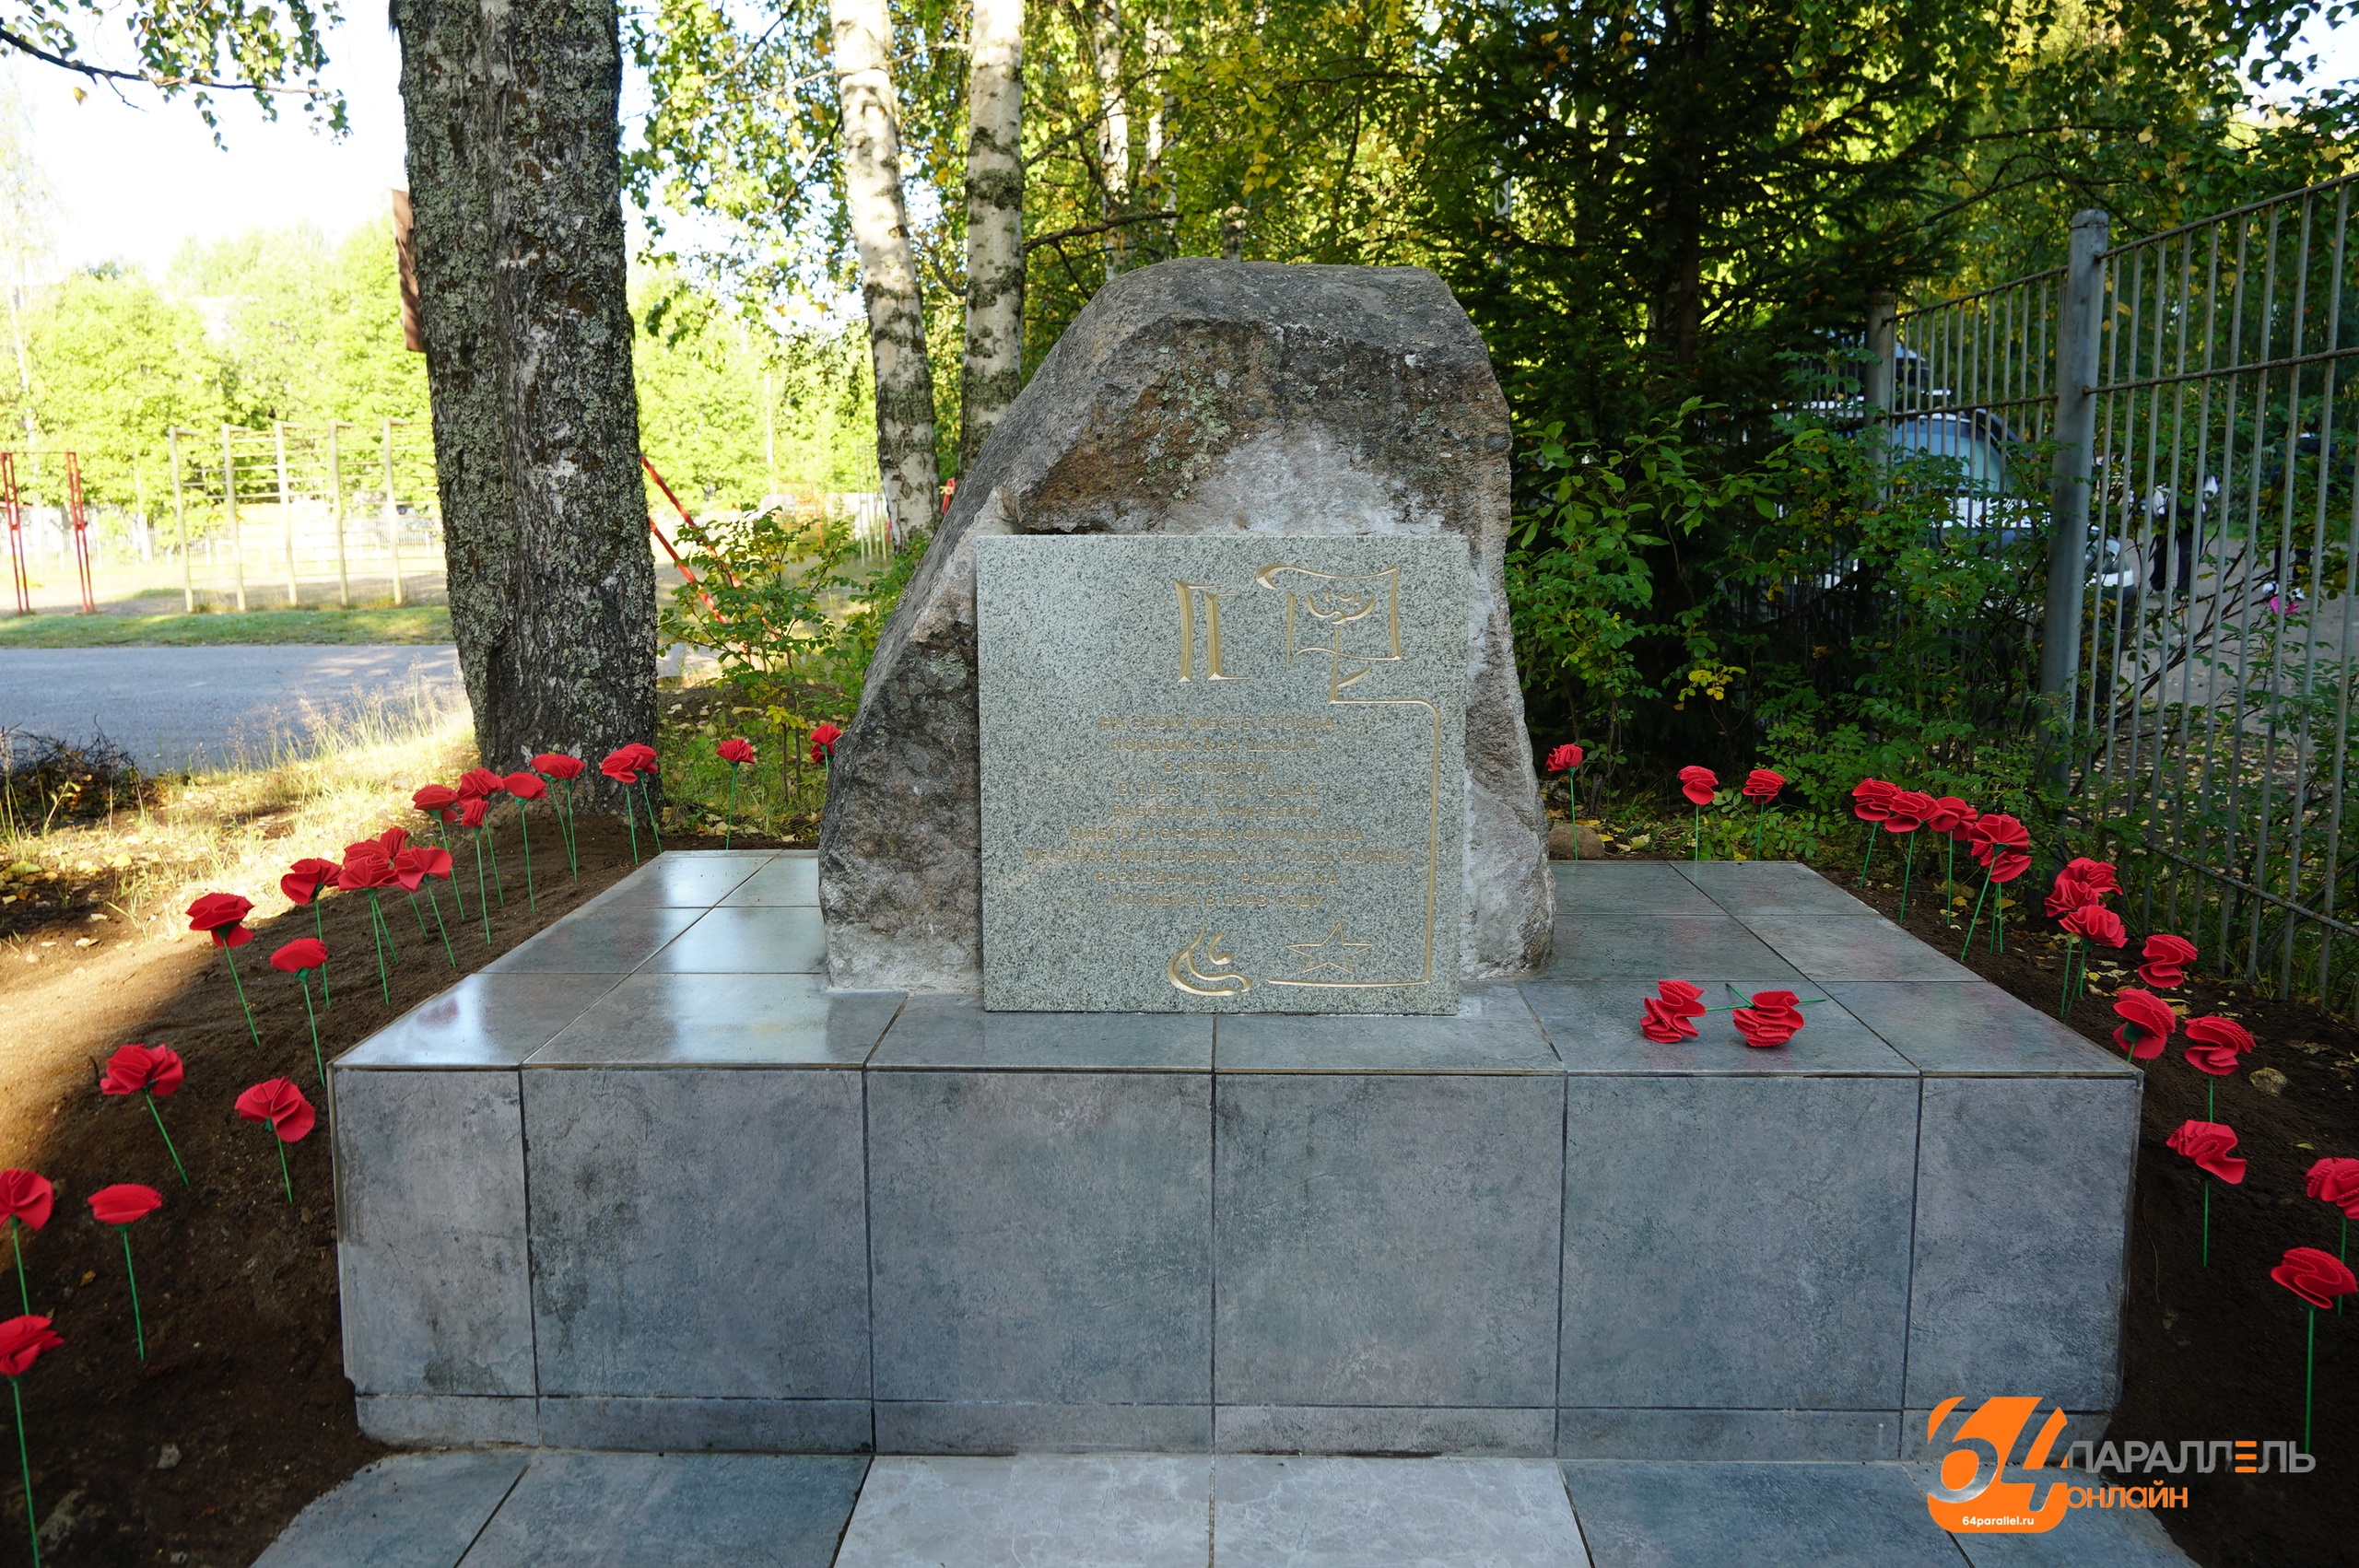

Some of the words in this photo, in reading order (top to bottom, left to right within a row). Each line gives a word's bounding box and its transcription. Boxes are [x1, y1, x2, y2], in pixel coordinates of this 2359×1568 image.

[1100, 717, 1126, 730] НА
[1133, 717, 1184, 730] ЭТОМ
[1191, 717, 1250, 730] МЕСТЕ
[1259, 717, 1335, 730] СТОЯЛА
[1247, 739, 1320, 752] ШКОЛА
[1163, 762, 1175, 774] В
[1182, 759, 1272, 774] КОТОРОЙ
[1118, 784, 1130, 796] В
[1254, 784, 1317, 798] ГОДАХ
[1110, 805, 1209, 818] РАБОТАЛА
[1216, 805, 1318, 818] УЧИТЕЛЕМ
[1070, 827, 1131, 840] ОЛЬГА
[1138, 827, 1235, 840] ЕГОРОВНА
[1243, 827, 1365, 841] ФИЛИППОВА
[1024, 849, 1110, 861] МЕСТНАЯ
[1264, 850, 1274, 862] В
[1281, 850, 1335, 864] ГОДЫ
[1342, 848, 1412, 863] ВОЙНЫ
[1096, 872, 1218, 885] РАЗВЕДЧИЦА
[1241, 872, 1338, 885] РАДИСТКА
[1109, 894, 1198, 907] ПОГИБЛА
[1205, 894, 1216, 907] В
[1225, 894, 1268, 907] 1943
[1275, 894, 1323, 908] ГОДУ
